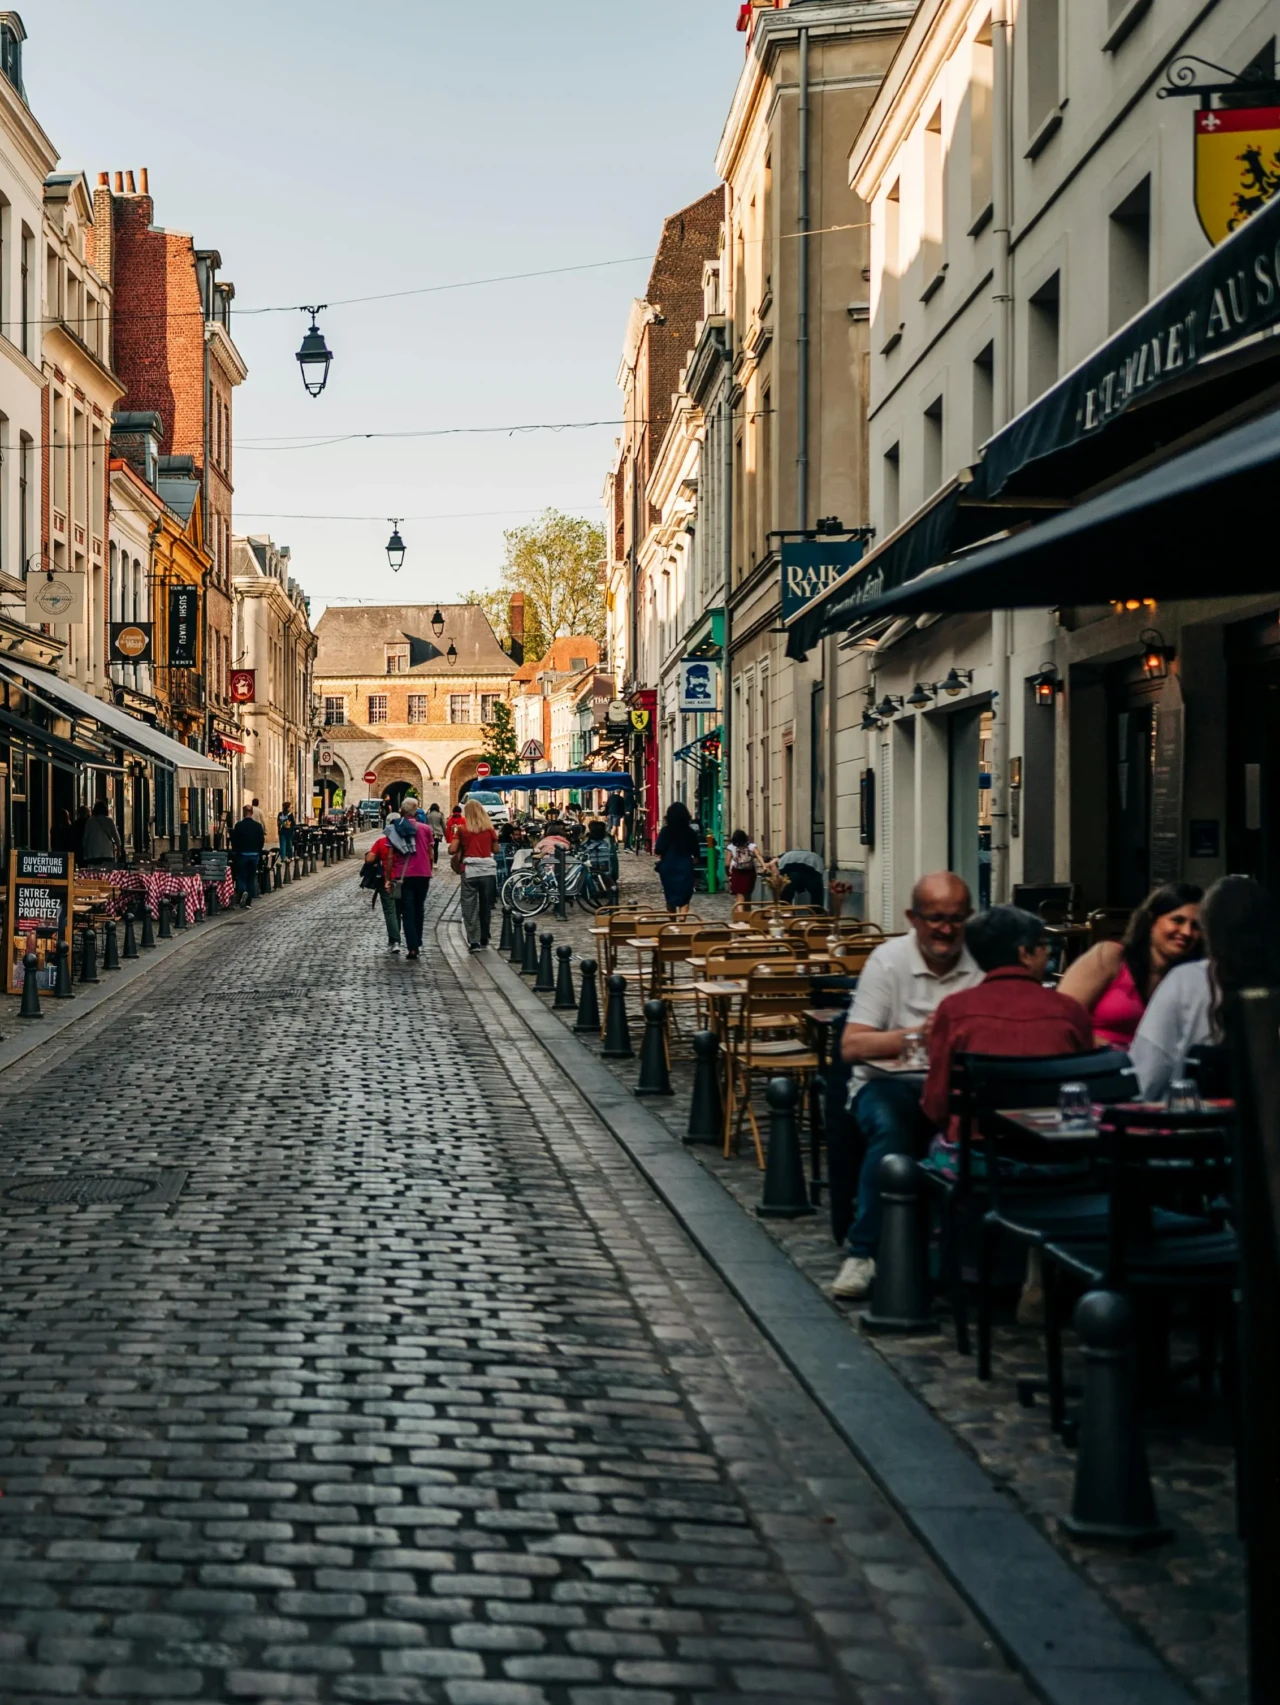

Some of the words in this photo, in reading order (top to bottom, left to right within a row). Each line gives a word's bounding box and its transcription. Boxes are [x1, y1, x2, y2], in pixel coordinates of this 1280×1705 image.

[1254, 239, 1280, 306] S
[786, 565, 853, 584] DAIK
[179, 595, 187, 617] SUSHI
[179, 624, 187, 645] WAFU
[23, 856, 63, 866] OUVERTURE
[23, 865, 32, 873] EN
[33, 865, 63, 874] CONTINU
[19, 887, 50, 898] ENTREZ
[18, 898, 61, 909] SAVOUREZ
[18, 908, 57, 919] PROFITEZ
